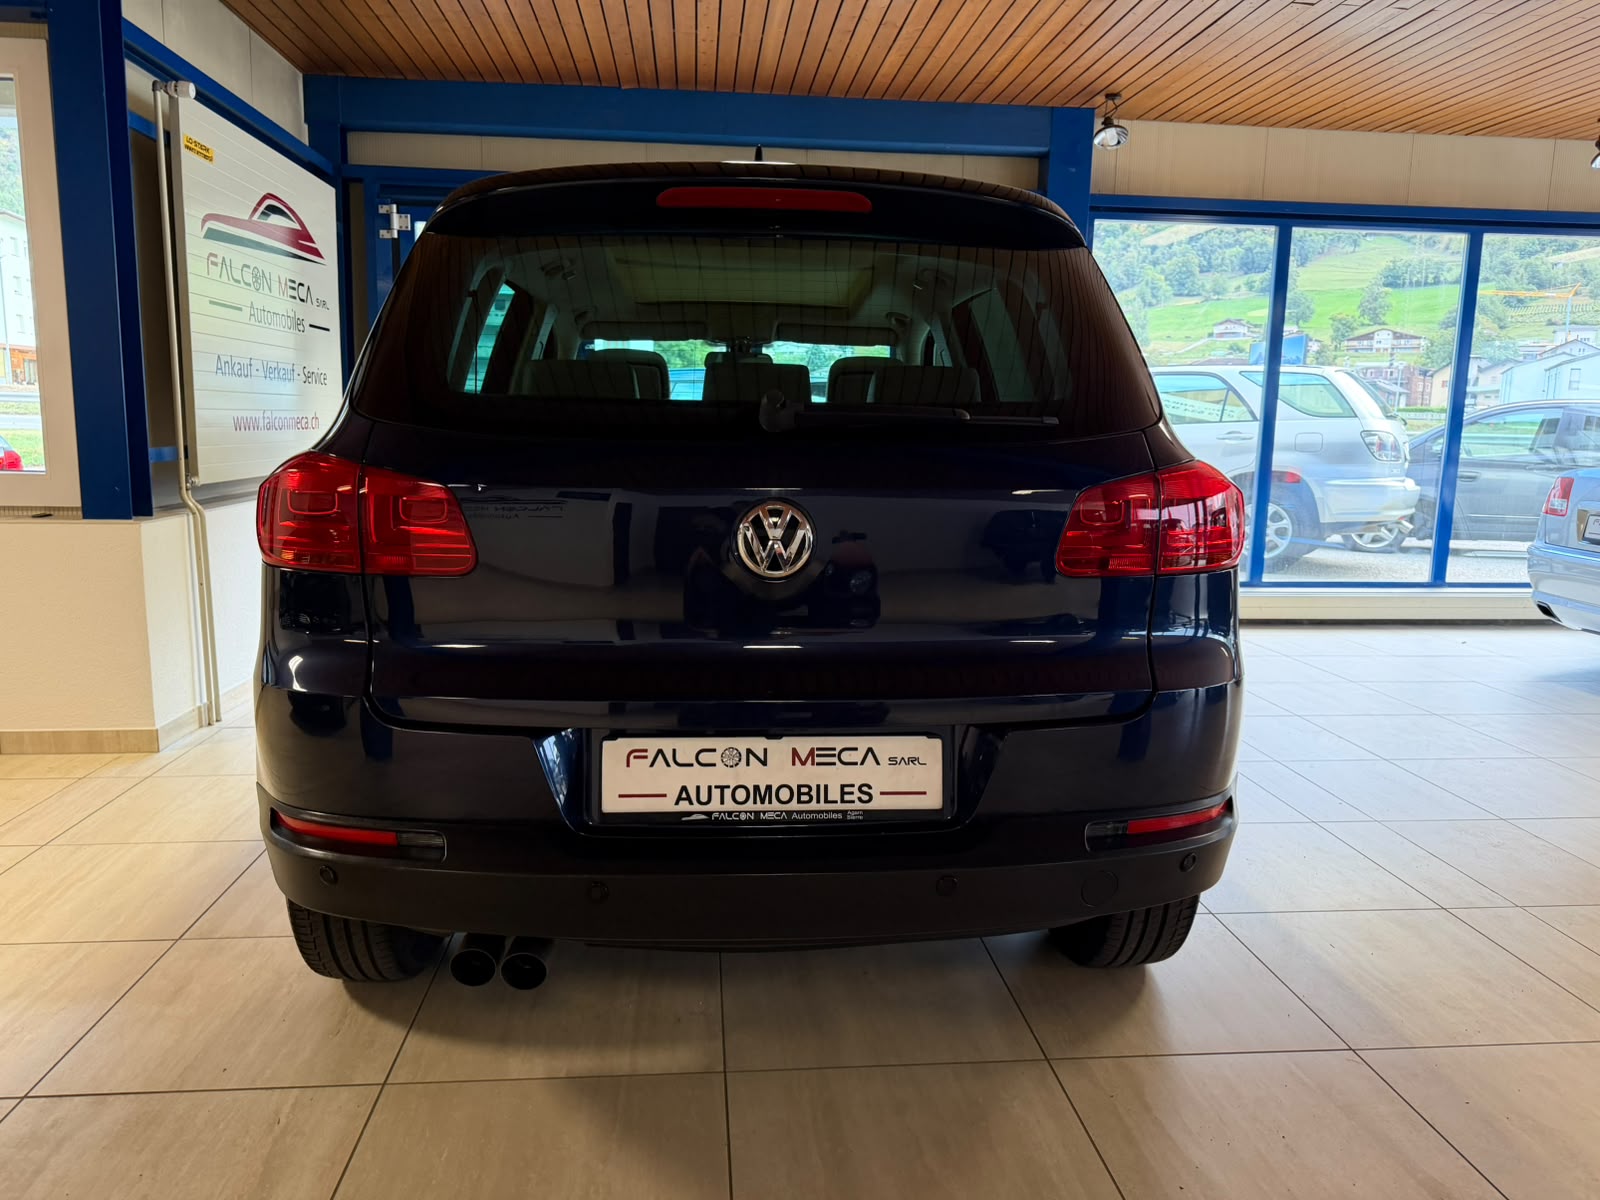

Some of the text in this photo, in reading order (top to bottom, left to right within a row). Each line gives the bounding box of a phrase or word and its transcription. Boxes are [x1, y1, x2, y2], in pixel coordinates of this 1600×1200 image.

[206, 252, 272, 293] FALCON
[278, 274, 314, 305] MECA
[249, 301, 306, 333] Automobiles
[215, 354, 253, 379] Ankauf
[261, 360, 296, 383] Verkauf
[302, 366, 328, 386] Service
[232, 410, 320, 432] www.falconmeca.ch
[625, 746, 928, 768] FALCON MECA SARL
[673, 783, 874, 806] AUTOMOBILES
[711, 811, 843, 821] FALCON MECA Automobiles
